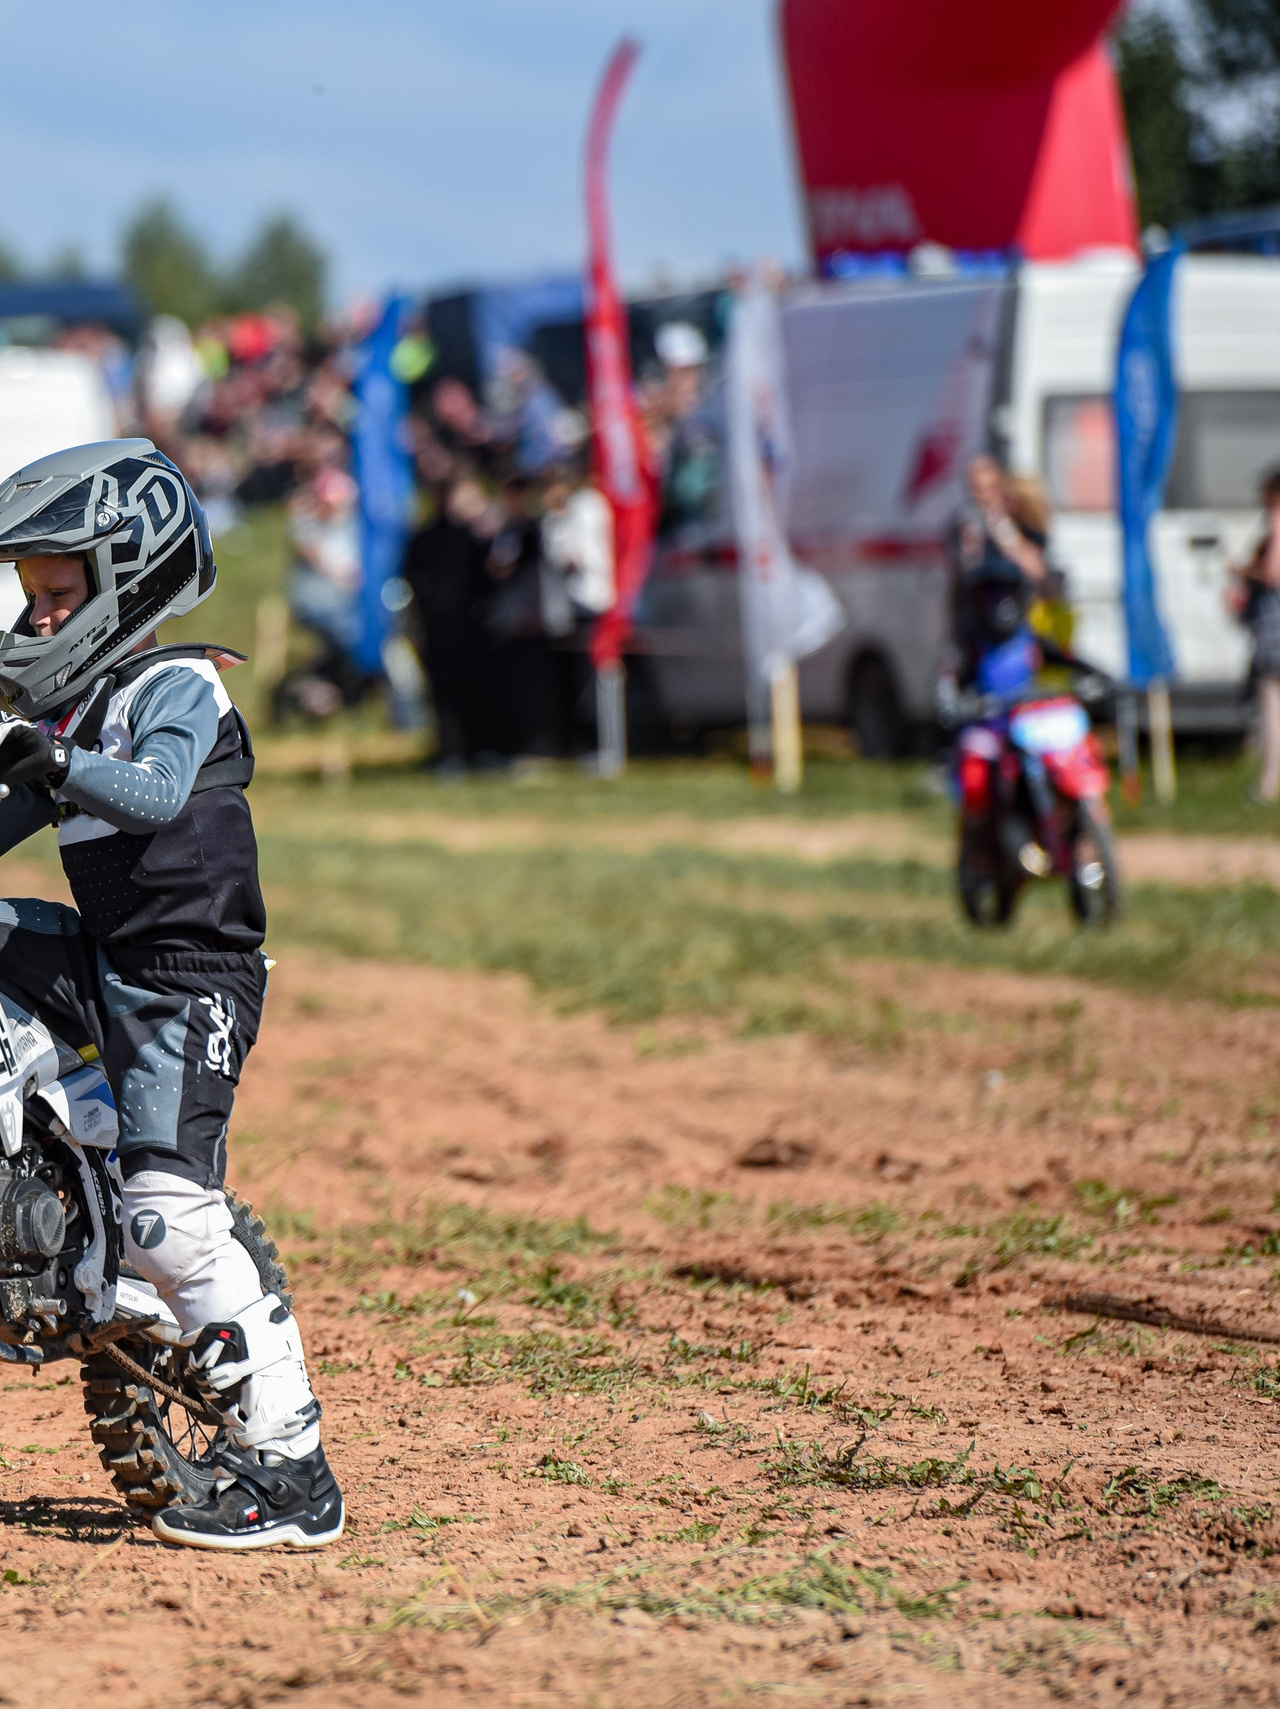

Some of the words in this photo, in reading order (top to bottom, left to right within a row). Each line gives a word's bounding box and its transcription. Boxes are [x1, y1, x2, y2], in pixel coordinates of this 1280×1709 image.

[68, 613, 111, 654] ATR-3
[81, 633, 128, 671] ADVANCED
[130, 604, 163, 633] IMPACT
[135, 1214, 160, 1246] 7
